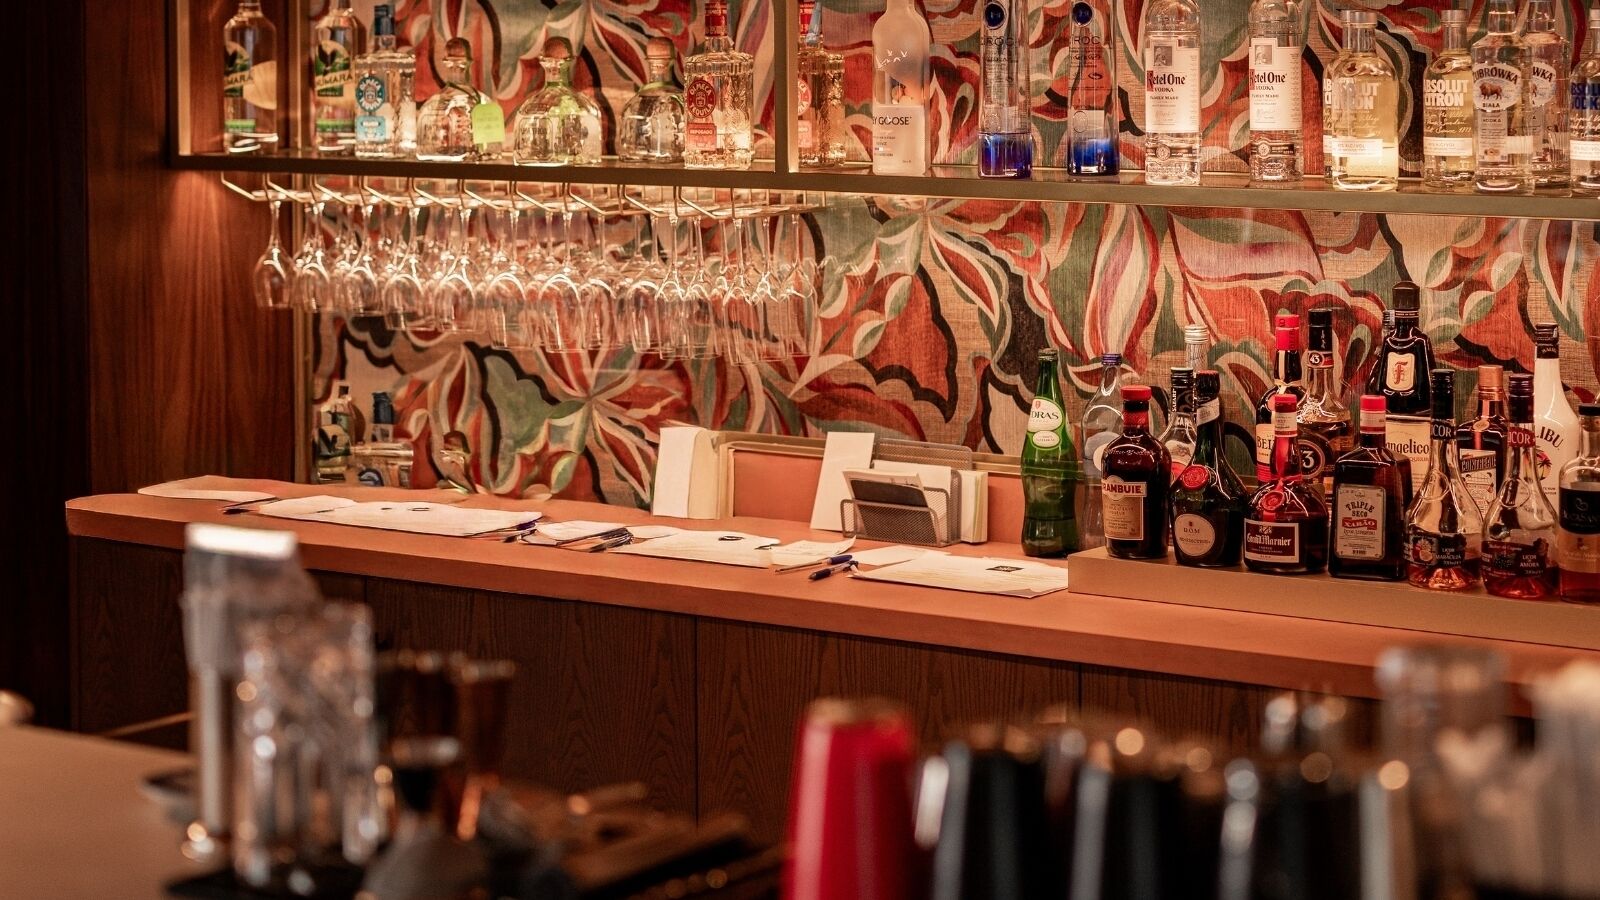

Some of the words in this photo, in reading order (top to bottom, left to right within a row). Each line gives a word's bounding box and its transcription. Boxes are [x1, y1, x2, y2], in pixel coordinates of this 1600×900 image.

[1167, 73, 1186, 85] One
[1267, 71, 1286, 83] One
[690, 83, 712, 95] OLMECA
[878, 116, 910, 126] GOOSE
[1309, 354, 1320, 363] 43
[1345, 501, 1375, 513] TRIPLE
[1351, 510, 1368, 518] SECO
